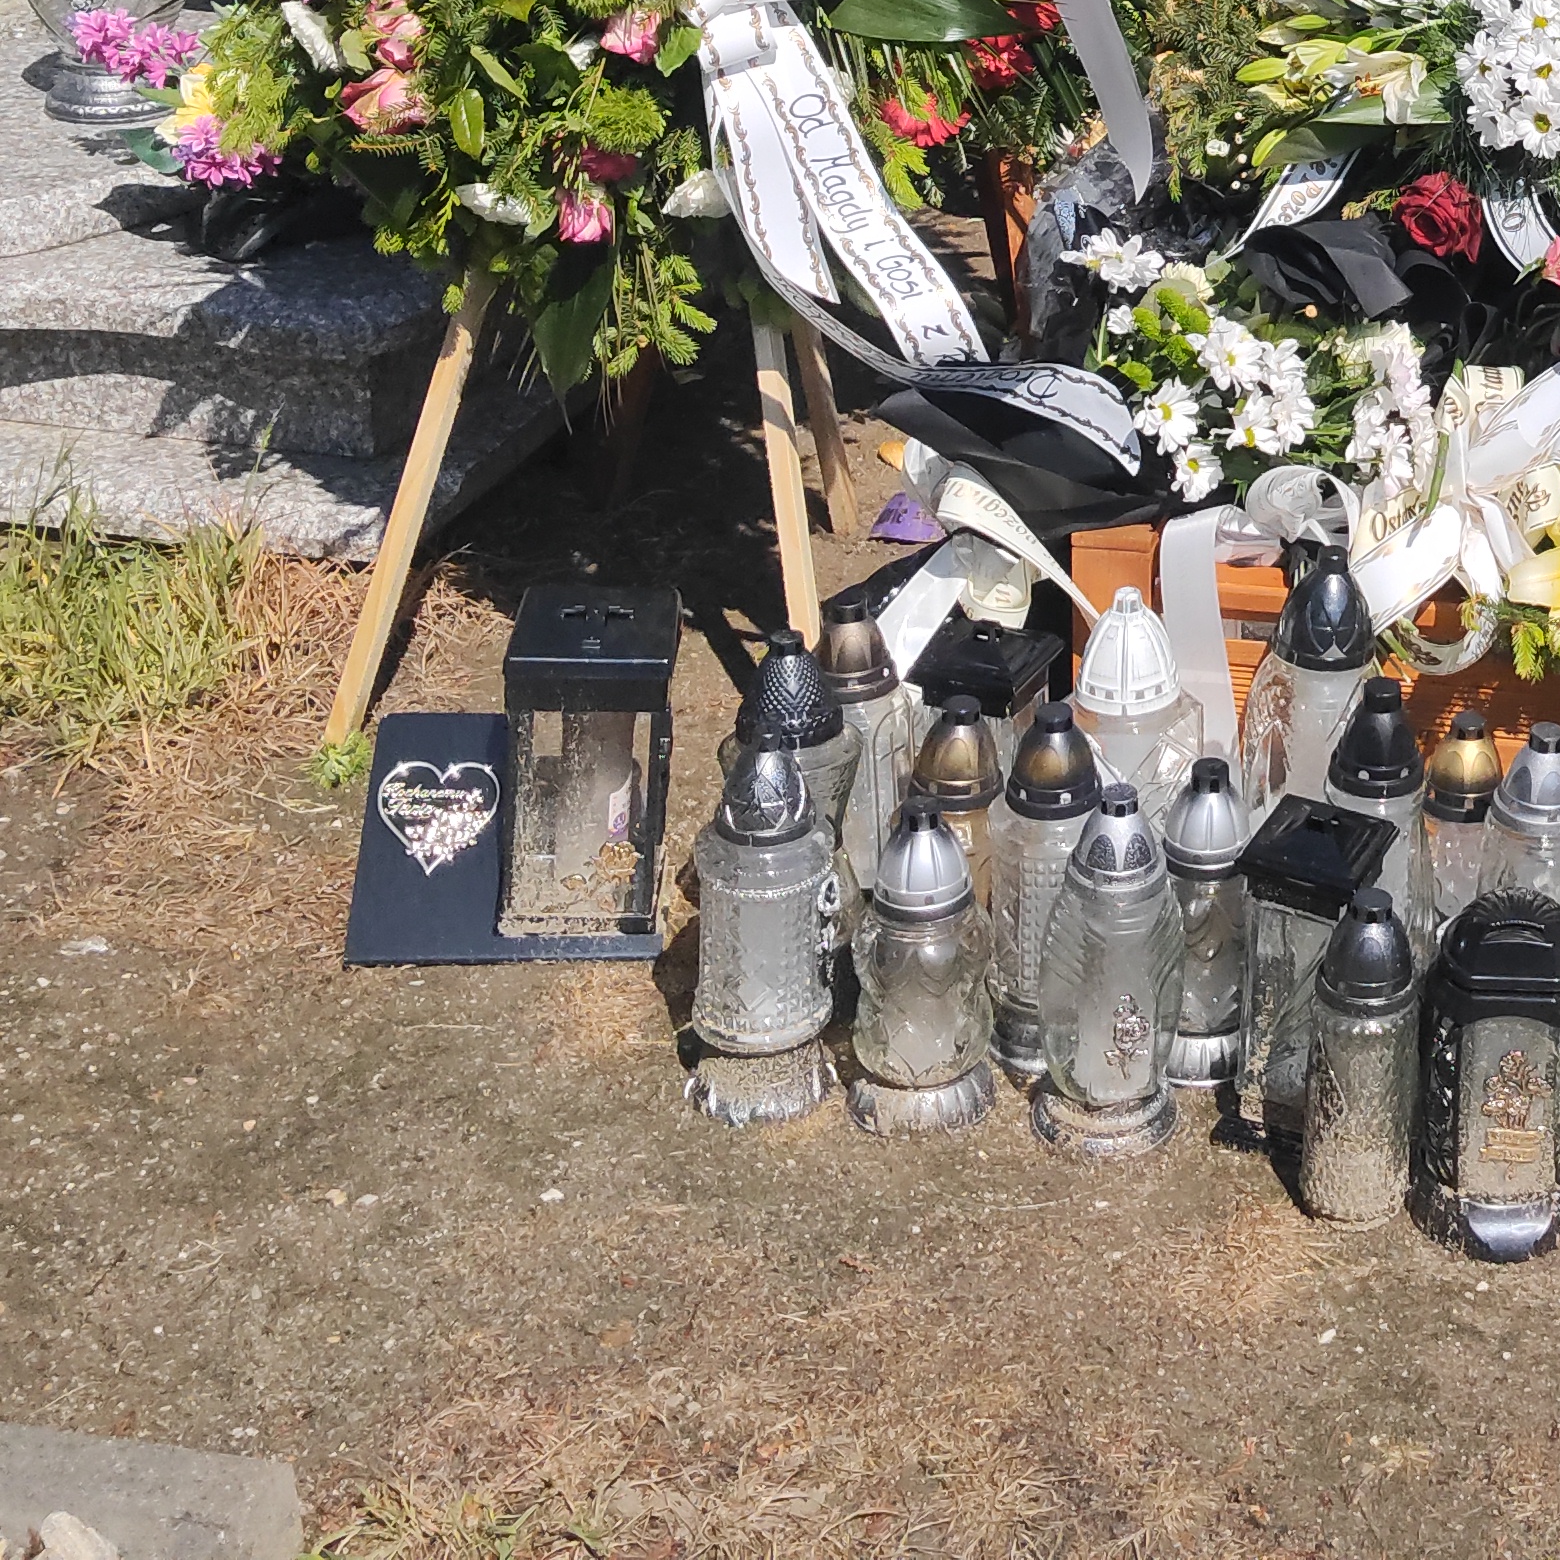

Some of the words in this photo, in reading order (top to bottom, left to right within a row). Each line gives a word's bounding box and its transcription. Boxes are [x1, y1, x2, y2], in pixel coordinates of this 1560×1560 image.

[789, 94, 834, 138] Od
[811, 155, 869, 234] Magdy
[877, 255, 933, 300] Gosi
